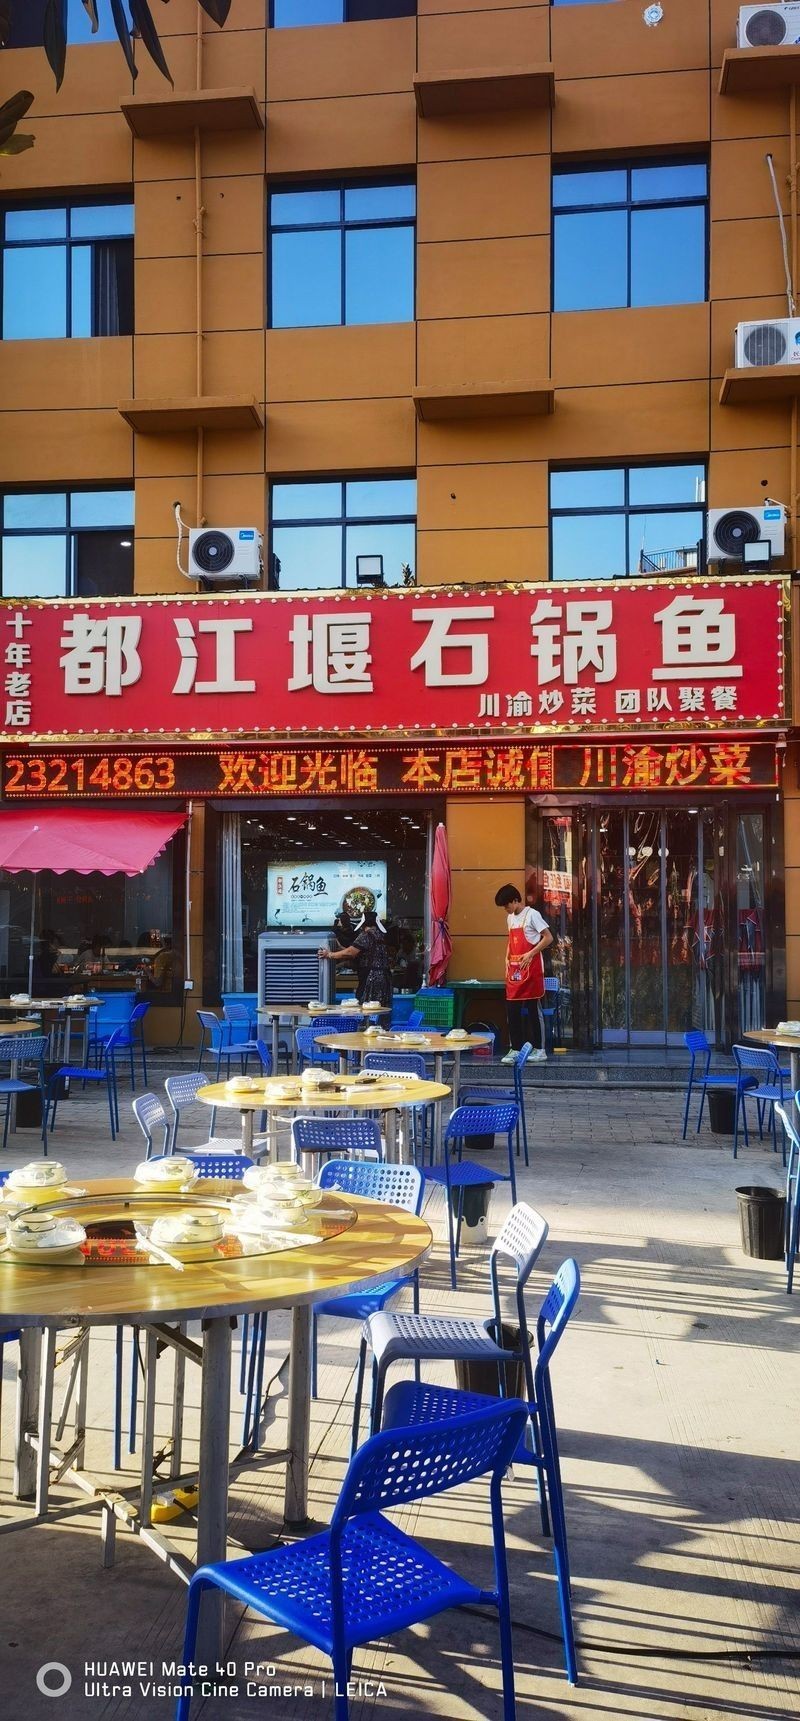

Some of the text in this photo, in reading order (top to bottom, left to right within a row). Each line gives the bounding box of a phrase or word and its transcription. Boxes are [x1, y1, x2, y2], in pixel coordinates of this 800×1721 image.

[59, 594, 744, 697] 都江堰石锅鱼
[4, 611, 33, 727] 十年老店
[477, 685, 739, 718] 川渝炒菜 团队聚餐
[4, 756, 176, 793] 23214863
[217, 750, 379, 793] 欢迎光临
[578, 743, 752, 787] 川渝炒菜
[288, 871, 329, 897] 石锅鱼
